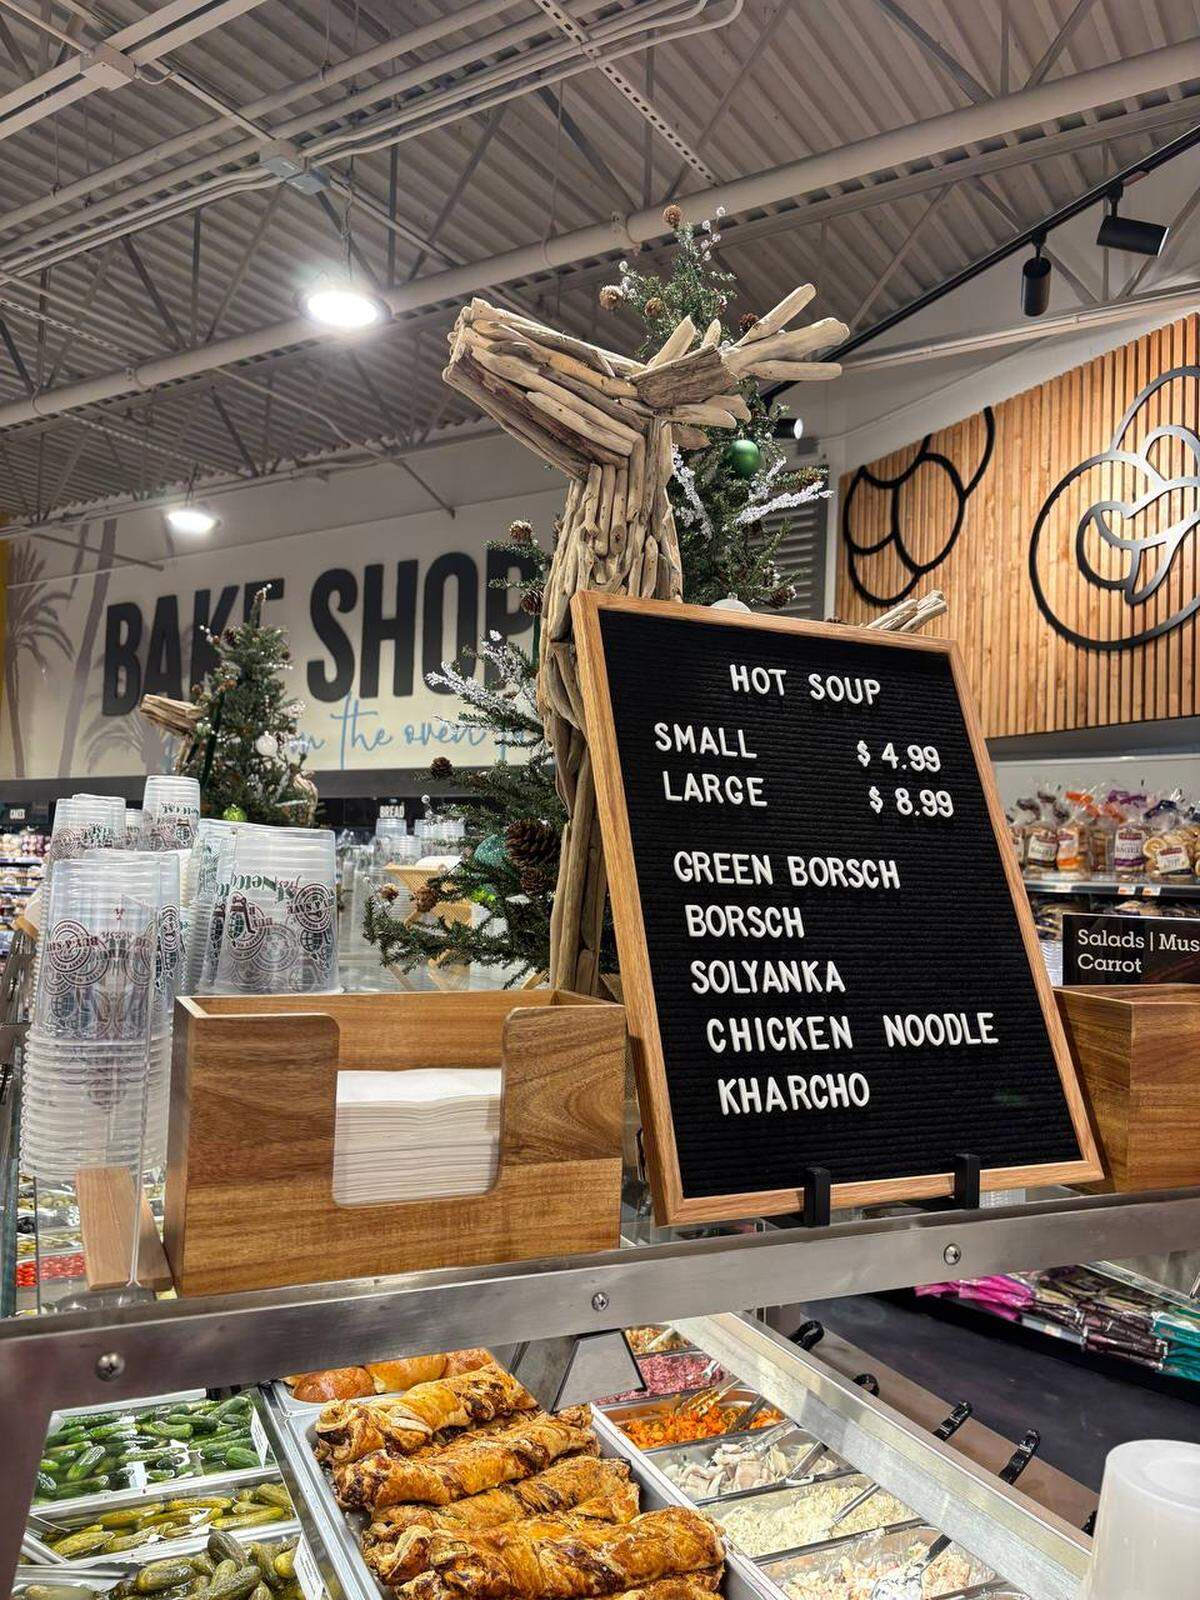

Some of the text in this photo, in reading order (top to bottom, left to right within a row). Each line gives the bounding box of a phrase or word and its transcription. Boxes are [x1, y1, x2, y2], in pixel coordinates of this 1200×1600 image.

[307, 547, 538, 702] SHOP
[729, 664, 881, 706] HOT SOUP
[330, 693, 393, 770] the
[654, 722, 942, 773] SMALL $ 4.99
[662, 770, 955, 819] LARGE $ 8.99
[673, 850, 901, 890] GREEN BORSCH
[684, 904, 805, 940] BORSCH
[1077, 928, 1145, 949] Salads
[1158, 932, 1200, 952] Mus
[690, 959, 846, 995] SOLYANKA
[1077, 953, 1142, 973] Carrot
[706, 1012, 999, 1054] CHICKEN NOODLE
[717, 1072, 870, 1115] KHARCHO
